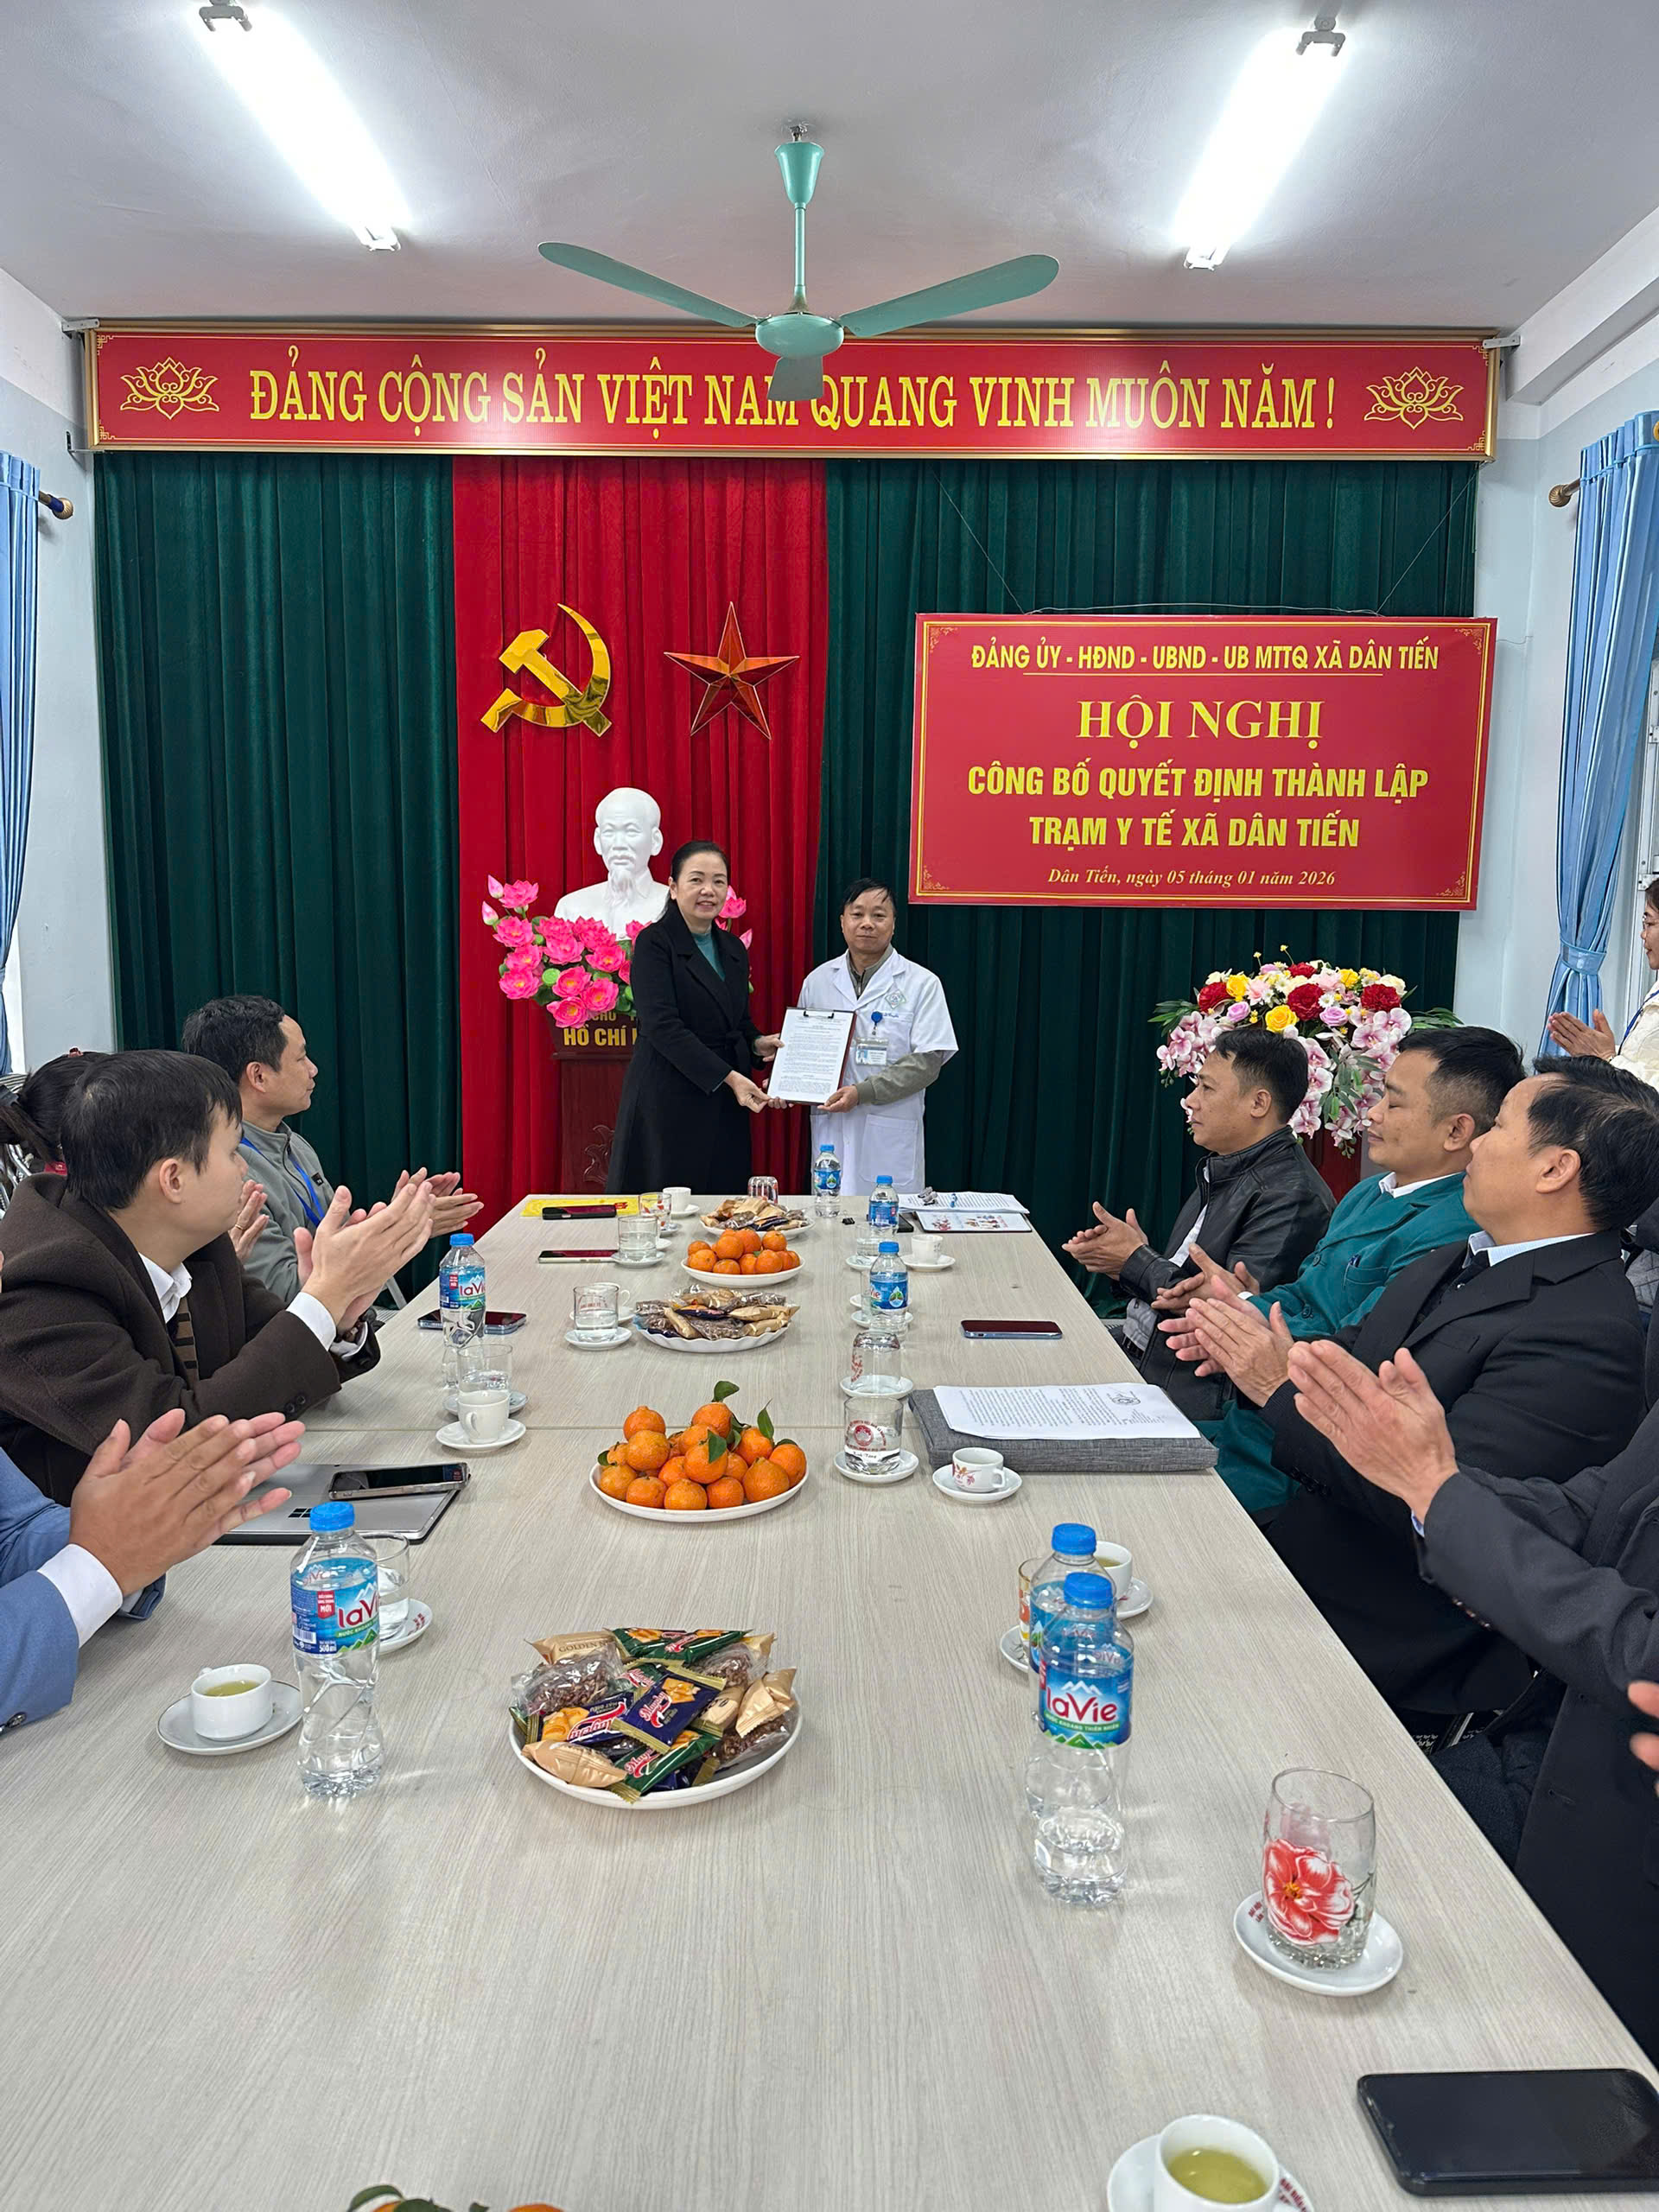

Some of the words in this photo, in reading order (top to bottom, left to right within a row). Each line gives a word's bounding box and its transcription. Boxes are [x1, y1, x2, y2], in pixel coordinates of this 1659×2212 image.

[250, 345, 367, 423] ĐẢNG
[378, 353, 492, 437] CỘNG
[502, 346, 584, 424] SẢN
[597, 356, 692, 439] VIỆT
[809, 374, 957, 430] QUANG
[969, 376, 1076, 429] VINH
[1085, 360, 1211, 429] MUÔN
[1220, 363, 1318, 429] NĂM
[1326, 378, 1335, 429] !
[971, 636, 1030, 669] ĐẢNG
[1036, 636, 1062, 669] ỦY
[1077, 645, 1135, 670] HĐND
[1153, 645, 1206, 670] UBND
[1224, 645, 1249, 670] UB
[1255, 645, 1308, 670] MTTQ
[1313, 639, 1342, 670] XÃ
[1349, 639, 1392, 670] DÂN
[1398, 636, 1439, 670] TIẾN
[1076, 694, 1173, 750] HỘI
[1187, 700, 1325, 750] NGHỊ
[968, 760, 1044, 796] CÔNG
[1052, 757, 1091, 796] BỐ
[1098, 759, 1186, 800] QUYẾT
[1194, 767, 1263, 803] ĐỊNH
[1271, 763, 1366, 798] THÀNH
[1374, 763, 1428, 804] LẬP
[1029, 817, 1107, 851] TRẠM
[1117, 817, 1132, 845] Y
[1141, 809, 1176, 846] TẾ
[1181, 813, 1219, 847] XÃ
[1228, 812, 1287, 847] DÂN
[1296, 810, 1360, 848] TIẾN
[1047, 868, 1078, 883] Dân
[1085, 865, 1121, 886] Tiến,
[1126, 870, 1162, 887] ngày
[1166, 870, 1185, 884] 05
[1189, 870, 1233, 888] tháng
[1237, 870, 1255, 885] 01
[1260, 871, 1294, 885] năm
[1298, 871, 1336, 885] 2026
[563, 1023, 589, 1046] HỒ
[594, 1025, 626, 1046] CHÍ
[460, 1281, 485, 1296] laVi
[338, 1590, 378, 1628] laVi
[558, 1641, 597, 1652] GOLDEN
[1046, 1687, 1117, 1723] laVie
